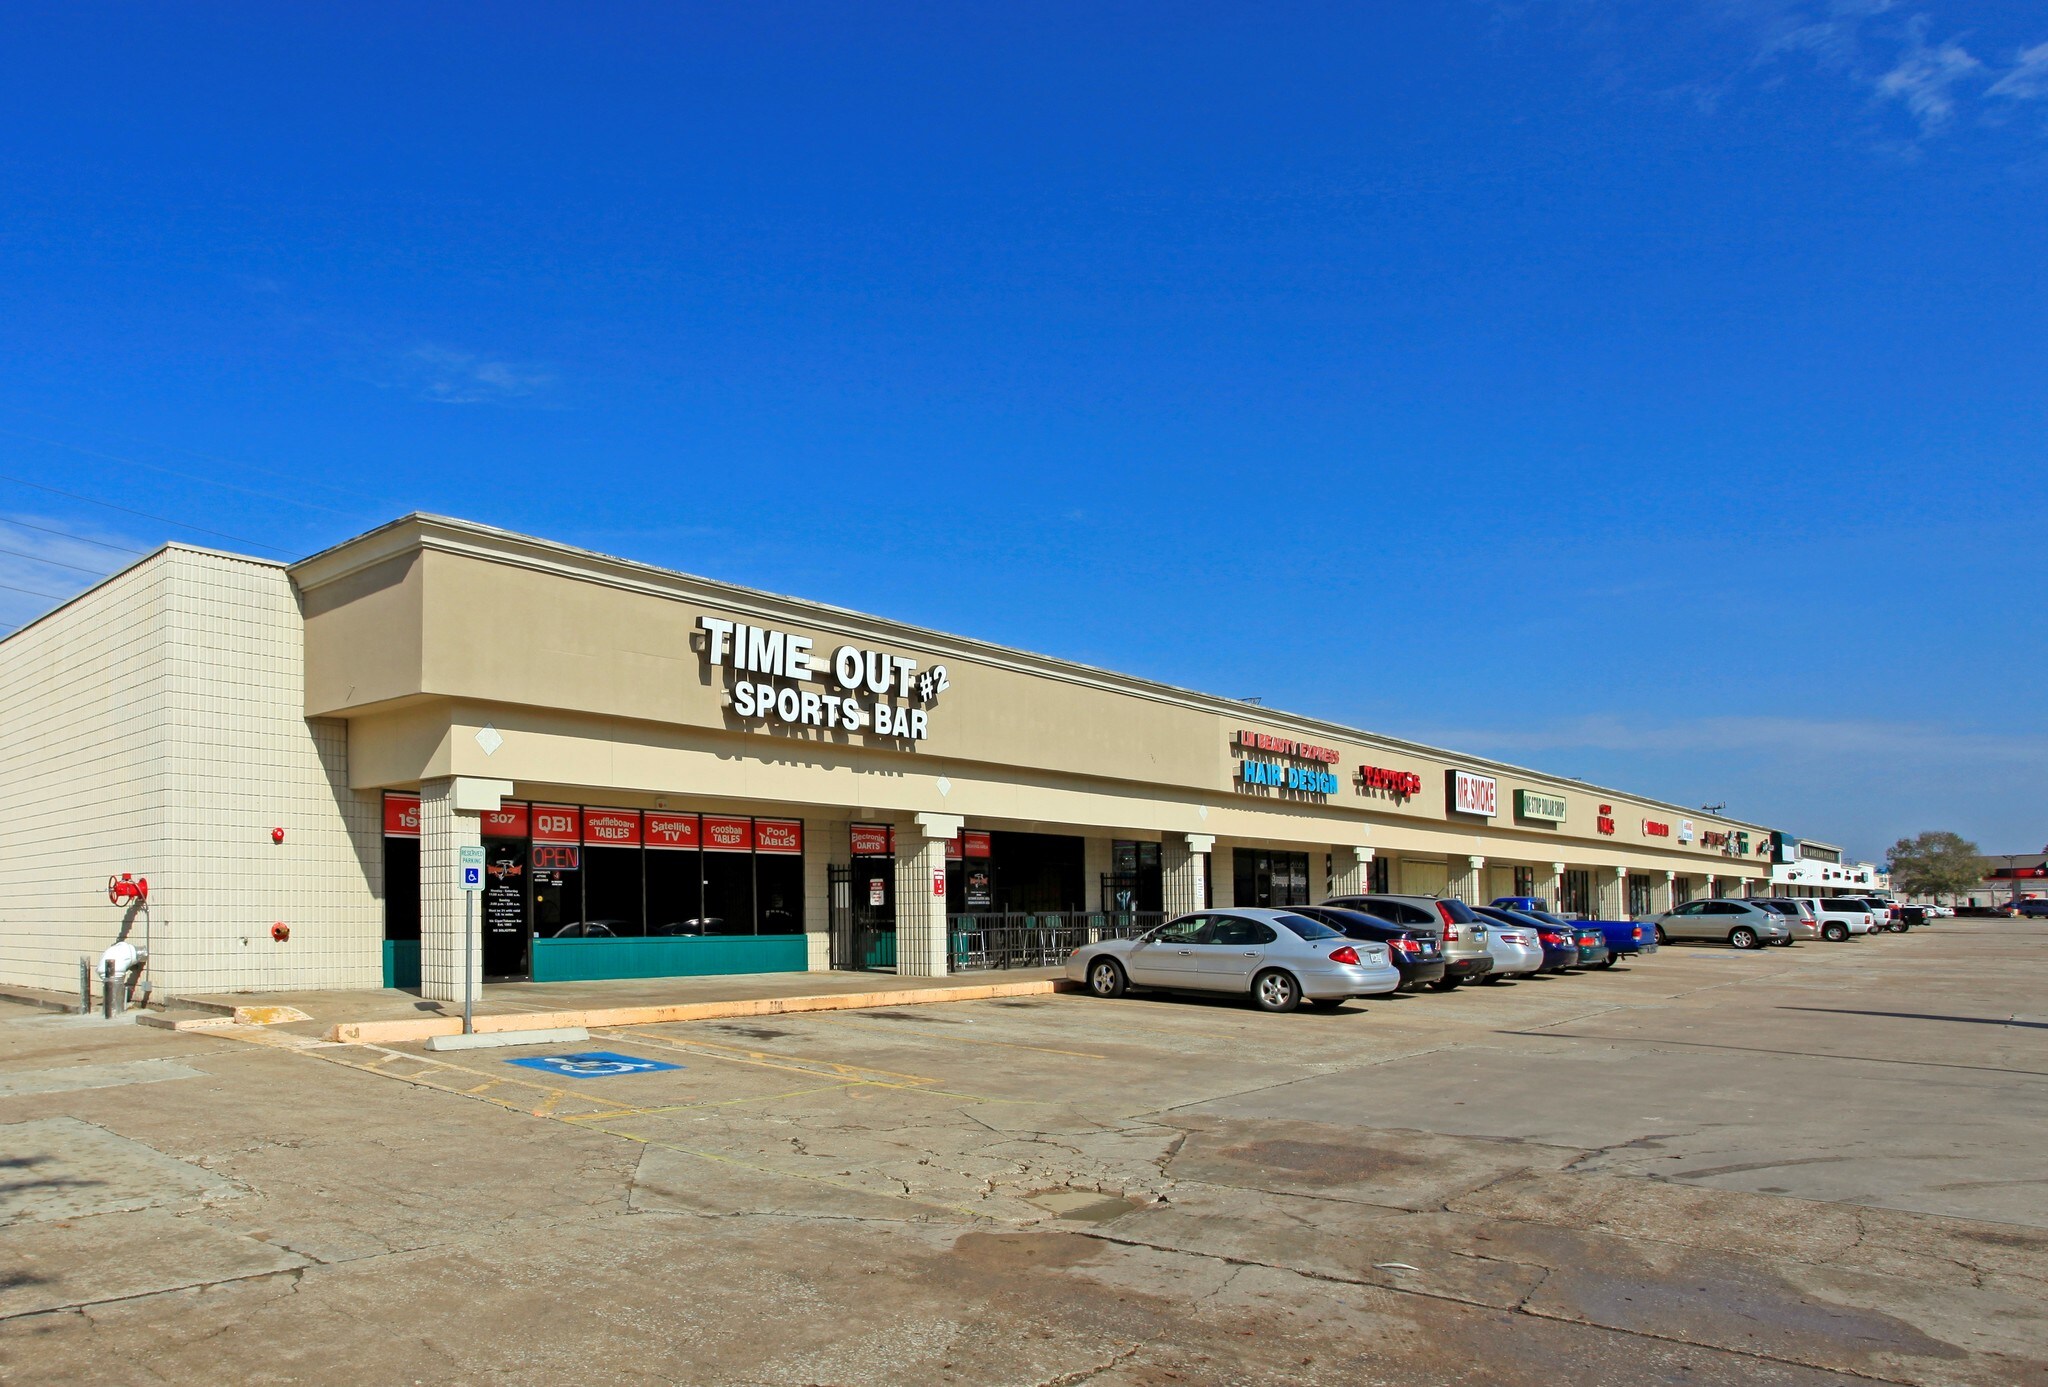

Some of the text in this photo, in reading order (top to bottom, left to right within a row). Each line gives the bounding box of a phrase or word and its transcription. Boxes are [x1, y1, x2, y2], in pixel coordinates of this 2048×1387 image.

[701, 616, 950, 703] TIME OUT #2
[734, 681, 928, 740] SPORTS BAR
[1257, 733, 1298, 756] BEAUTY
[1300, 742, 1340, 765] EXPRESS
[1245, 760, 1338, 795] HAIR DESIGN
[1457, 776, 1494, 813] MR. SMOKE
[490, 814, 516, 824] 307
[538, 815, 573, 834] QB1
[594, 826, 630, 839] TABLES
[651, 820, 691, 835] Satellite
[710, 825, 743, 835] Foosball
[766, 827, 788, 837] Pool
[663, 830, 680, 842] TV
[713, 832, 740, 844] TABLES
[758, 833, 796, 847] TABLES
[851, 832, 885, 844] Electronic
[856, 841, 880, 850] DARTS
[532, 847, 576, 867] OPEN
